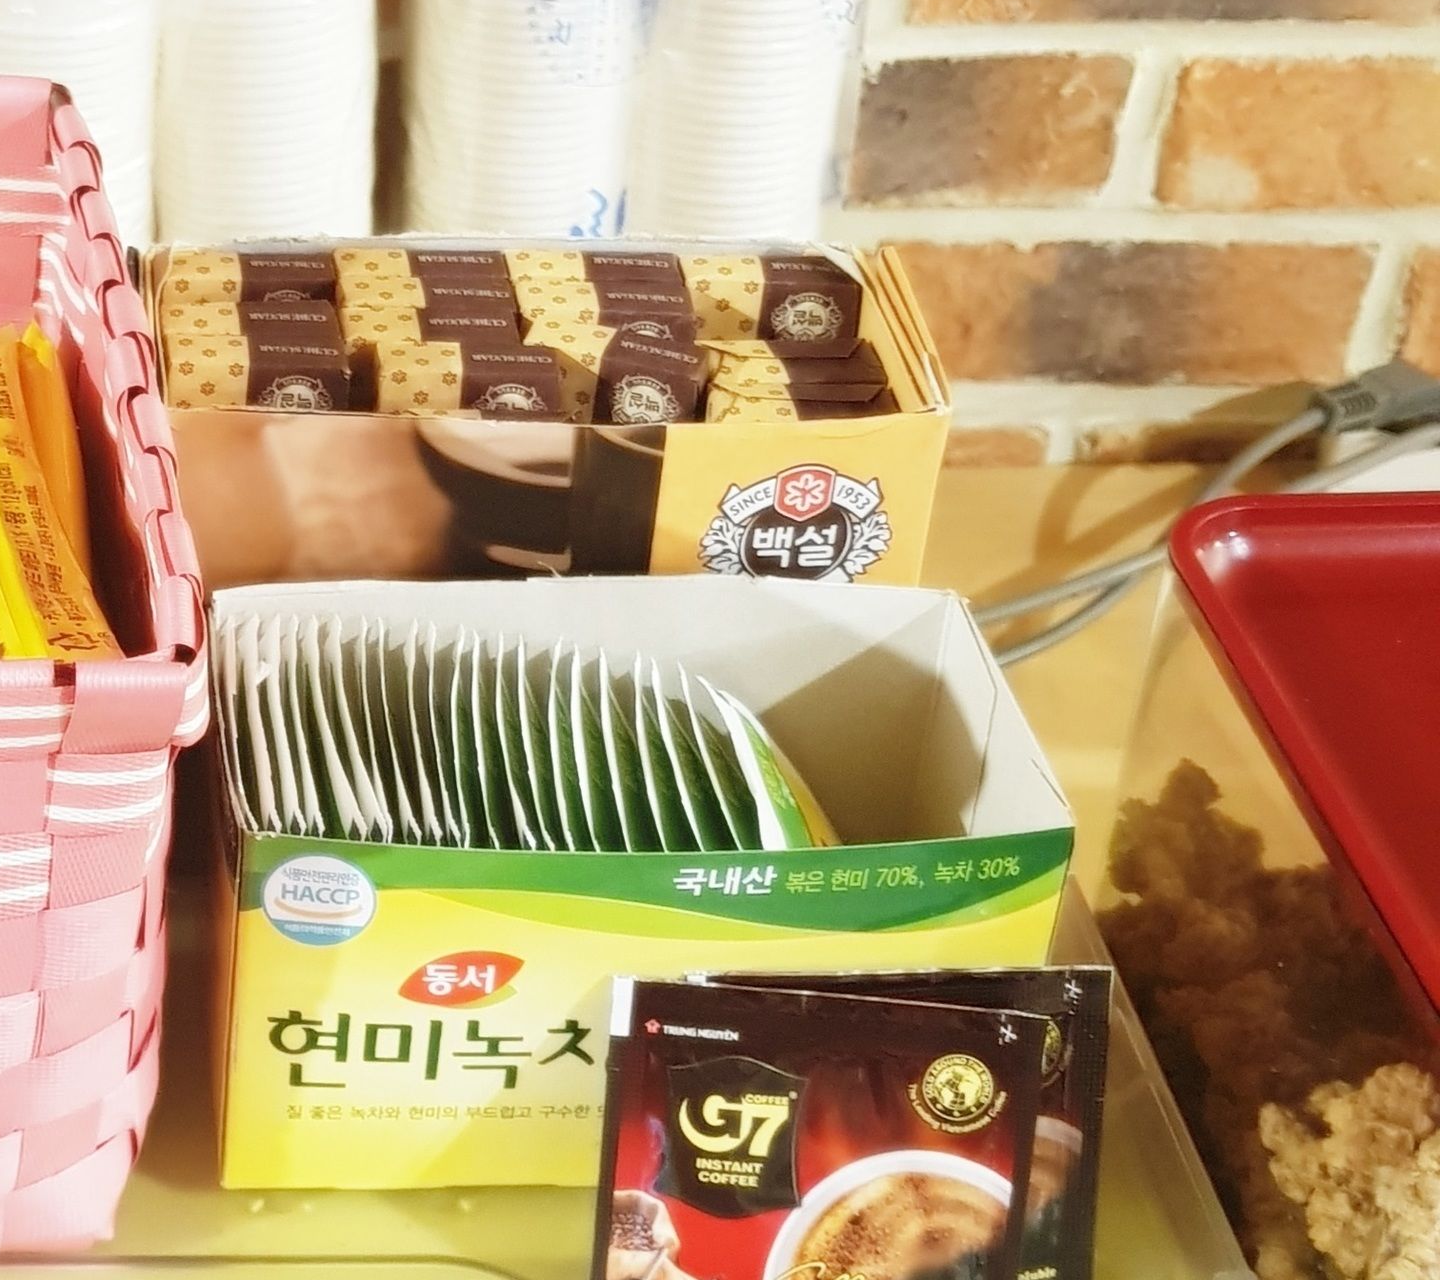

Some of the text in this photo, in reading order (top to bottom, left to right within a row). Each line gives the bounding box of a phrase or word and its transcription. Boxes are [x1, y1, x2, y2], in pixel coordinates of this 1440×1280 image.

[729, 484, 872, 517] SINCE 1953
[752, 524, 839, 569] 백설
[673, 855, 1021, 896] 국내산 볶은 현미 70%, 녹차 30%
[281, 883, 360, 905] HACCP
[422, 964, 496, 996] 동서
[287, 1104, 303, 1119] 질
[310, 1105, 342, 1119] 좋은
[351, 1105, 400, 1120] 녹차와
[409, 1105, 457, 1120] 현미의
[466, 1104, 531, 1119] 부드럽고
[538, 1104, 589, 1119] 구수한
[744, 1094, 790, 1106] COFFEE
[679, 1094, 789, 1157] G7
[696, 1158, 763, 1174] INSTANT
[698, 1171, 759, 1187] COFFEE
